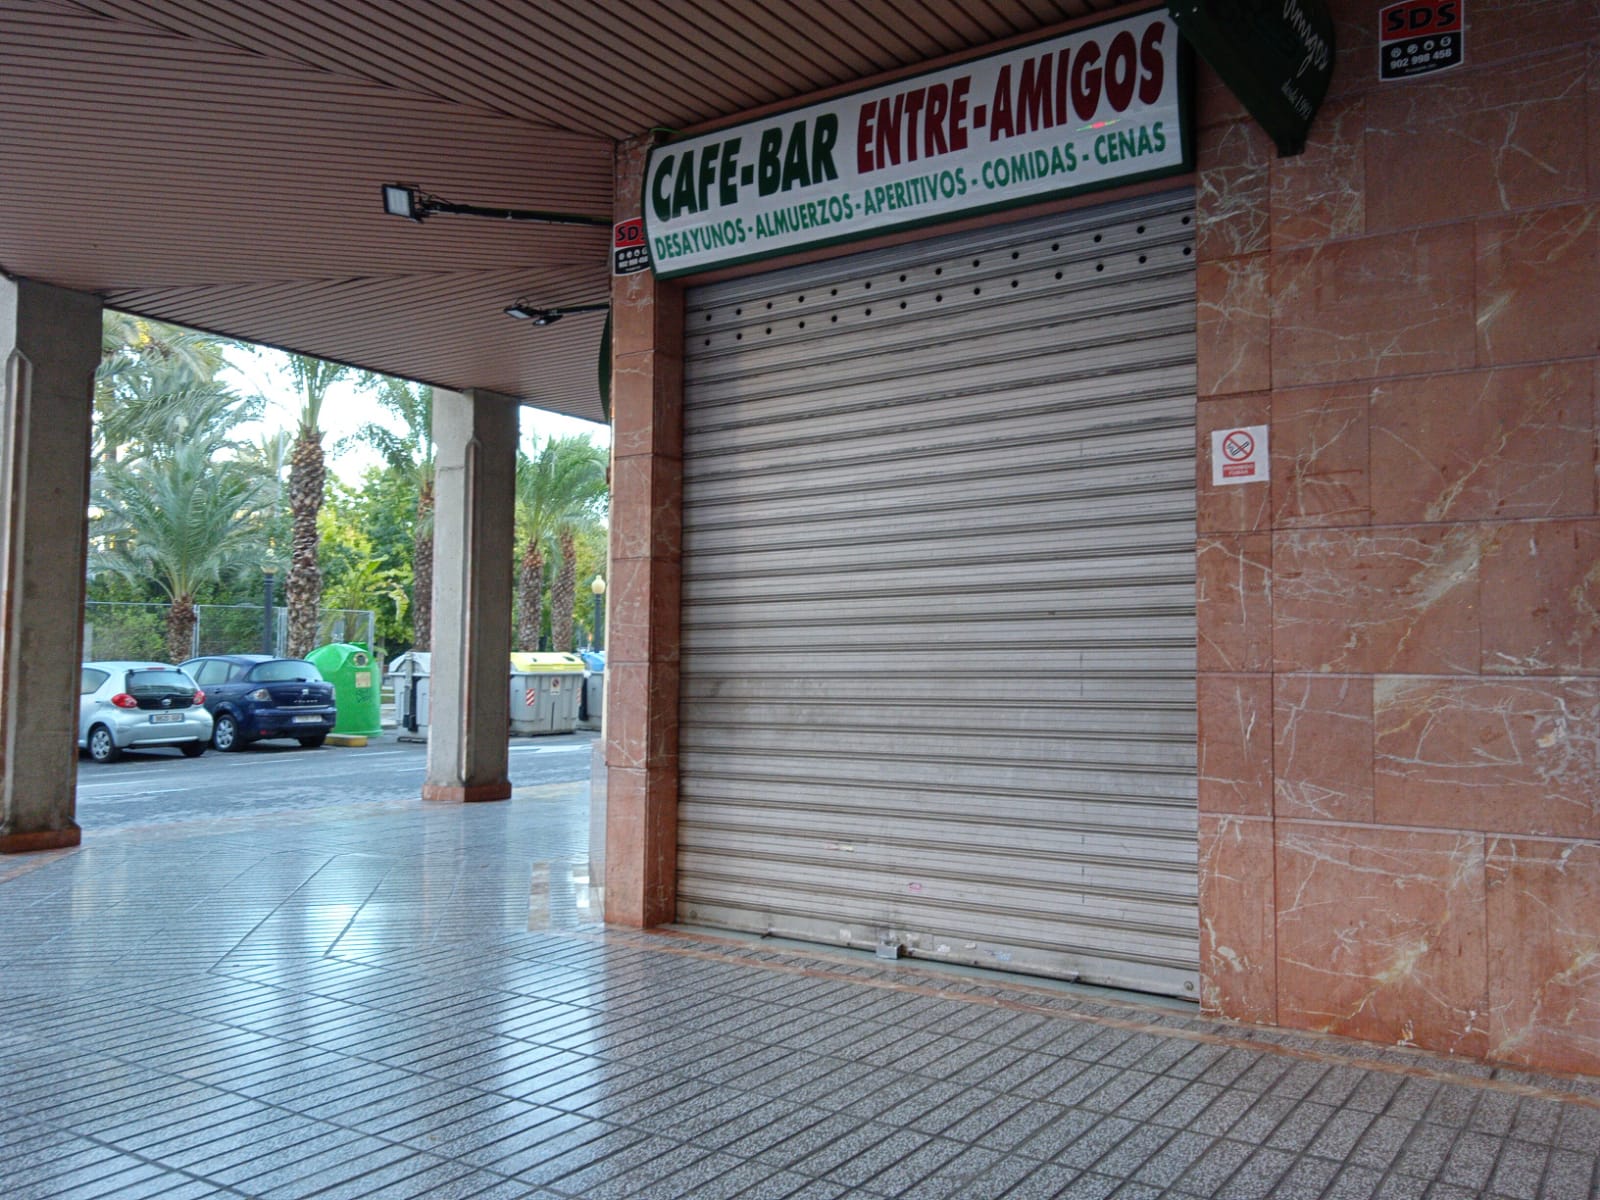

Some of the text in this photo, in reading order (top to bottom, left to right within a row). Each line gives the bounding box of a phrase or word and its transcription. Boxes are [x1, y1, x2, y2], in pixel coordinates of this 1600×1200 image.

[1387, 2, 1456, 32] SDS
[1390, 57, 1409, 70] 902
[652, 21, 1166, 222] CAFE-BAR ENTRE-AMIGOS
[1094, 121, 1166, 165] CENAS
[618, 226, 645, 241] SD
